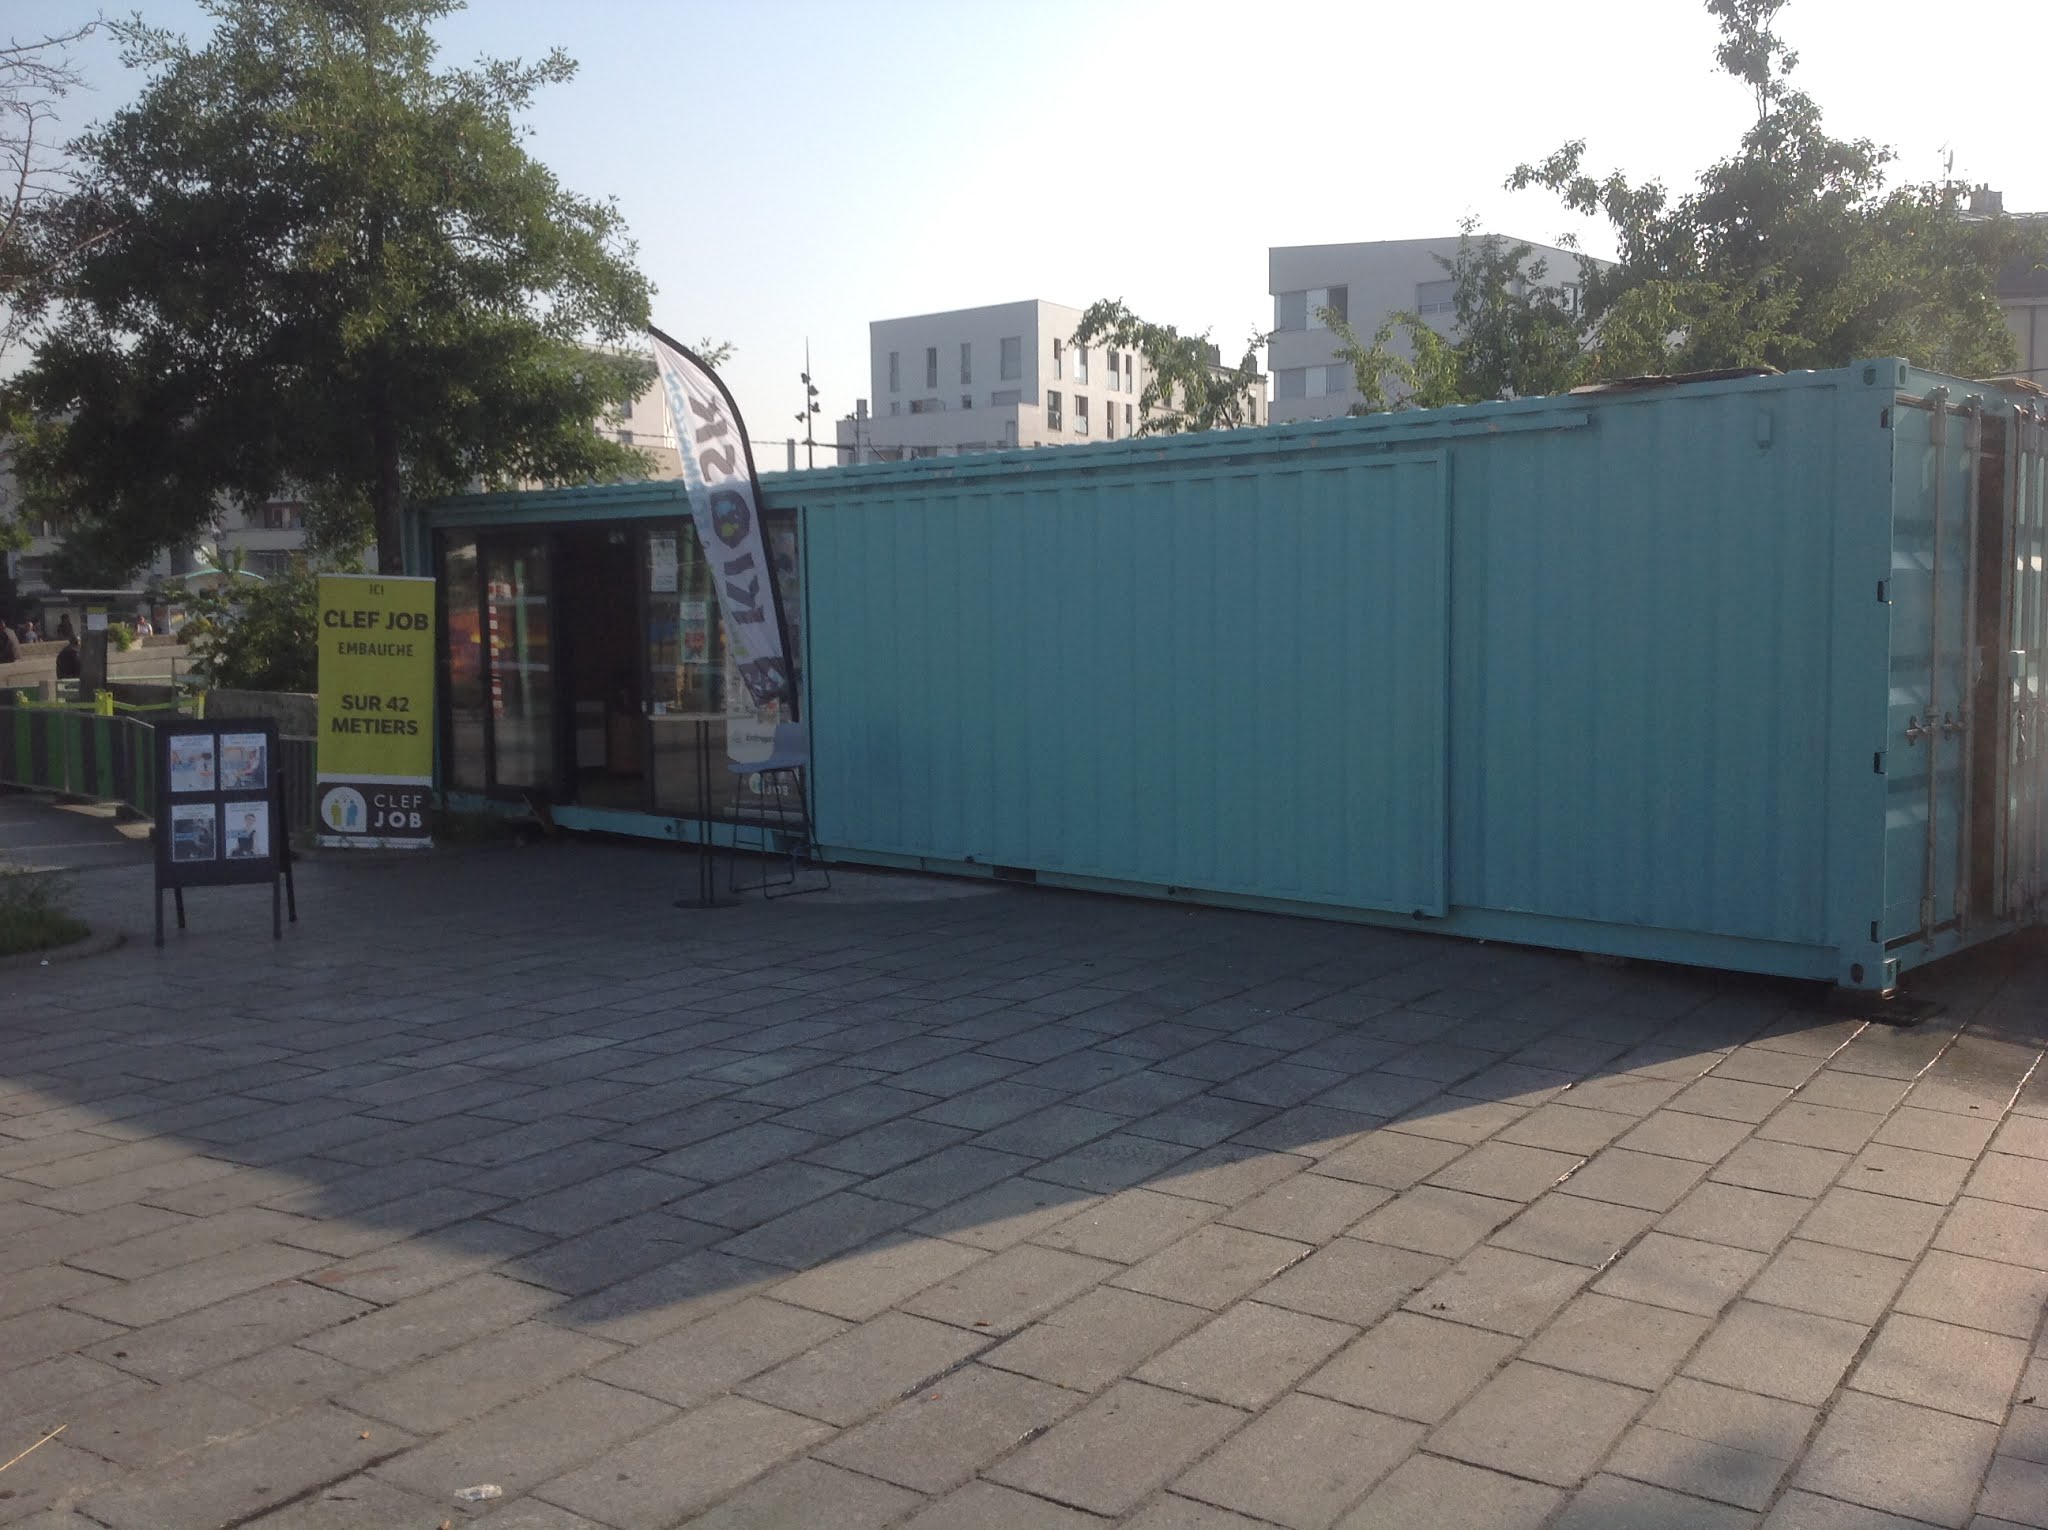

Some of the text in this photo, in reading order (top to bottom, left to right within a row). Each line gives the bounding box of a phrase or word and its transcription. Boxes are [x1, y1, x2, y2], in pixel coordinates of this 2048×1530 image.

[369, 584, 384, 595] ICI
[323, 609, 429, 631] CLEF JOB
[338, 642, 414, 656] EMBAUCHE
[341, 695, 410, 711] SUR 42
[331, 718, 418, 735] METIERS
[374, 795, 422, 809] CLEF
[374, 812, 422, 828] JOB
